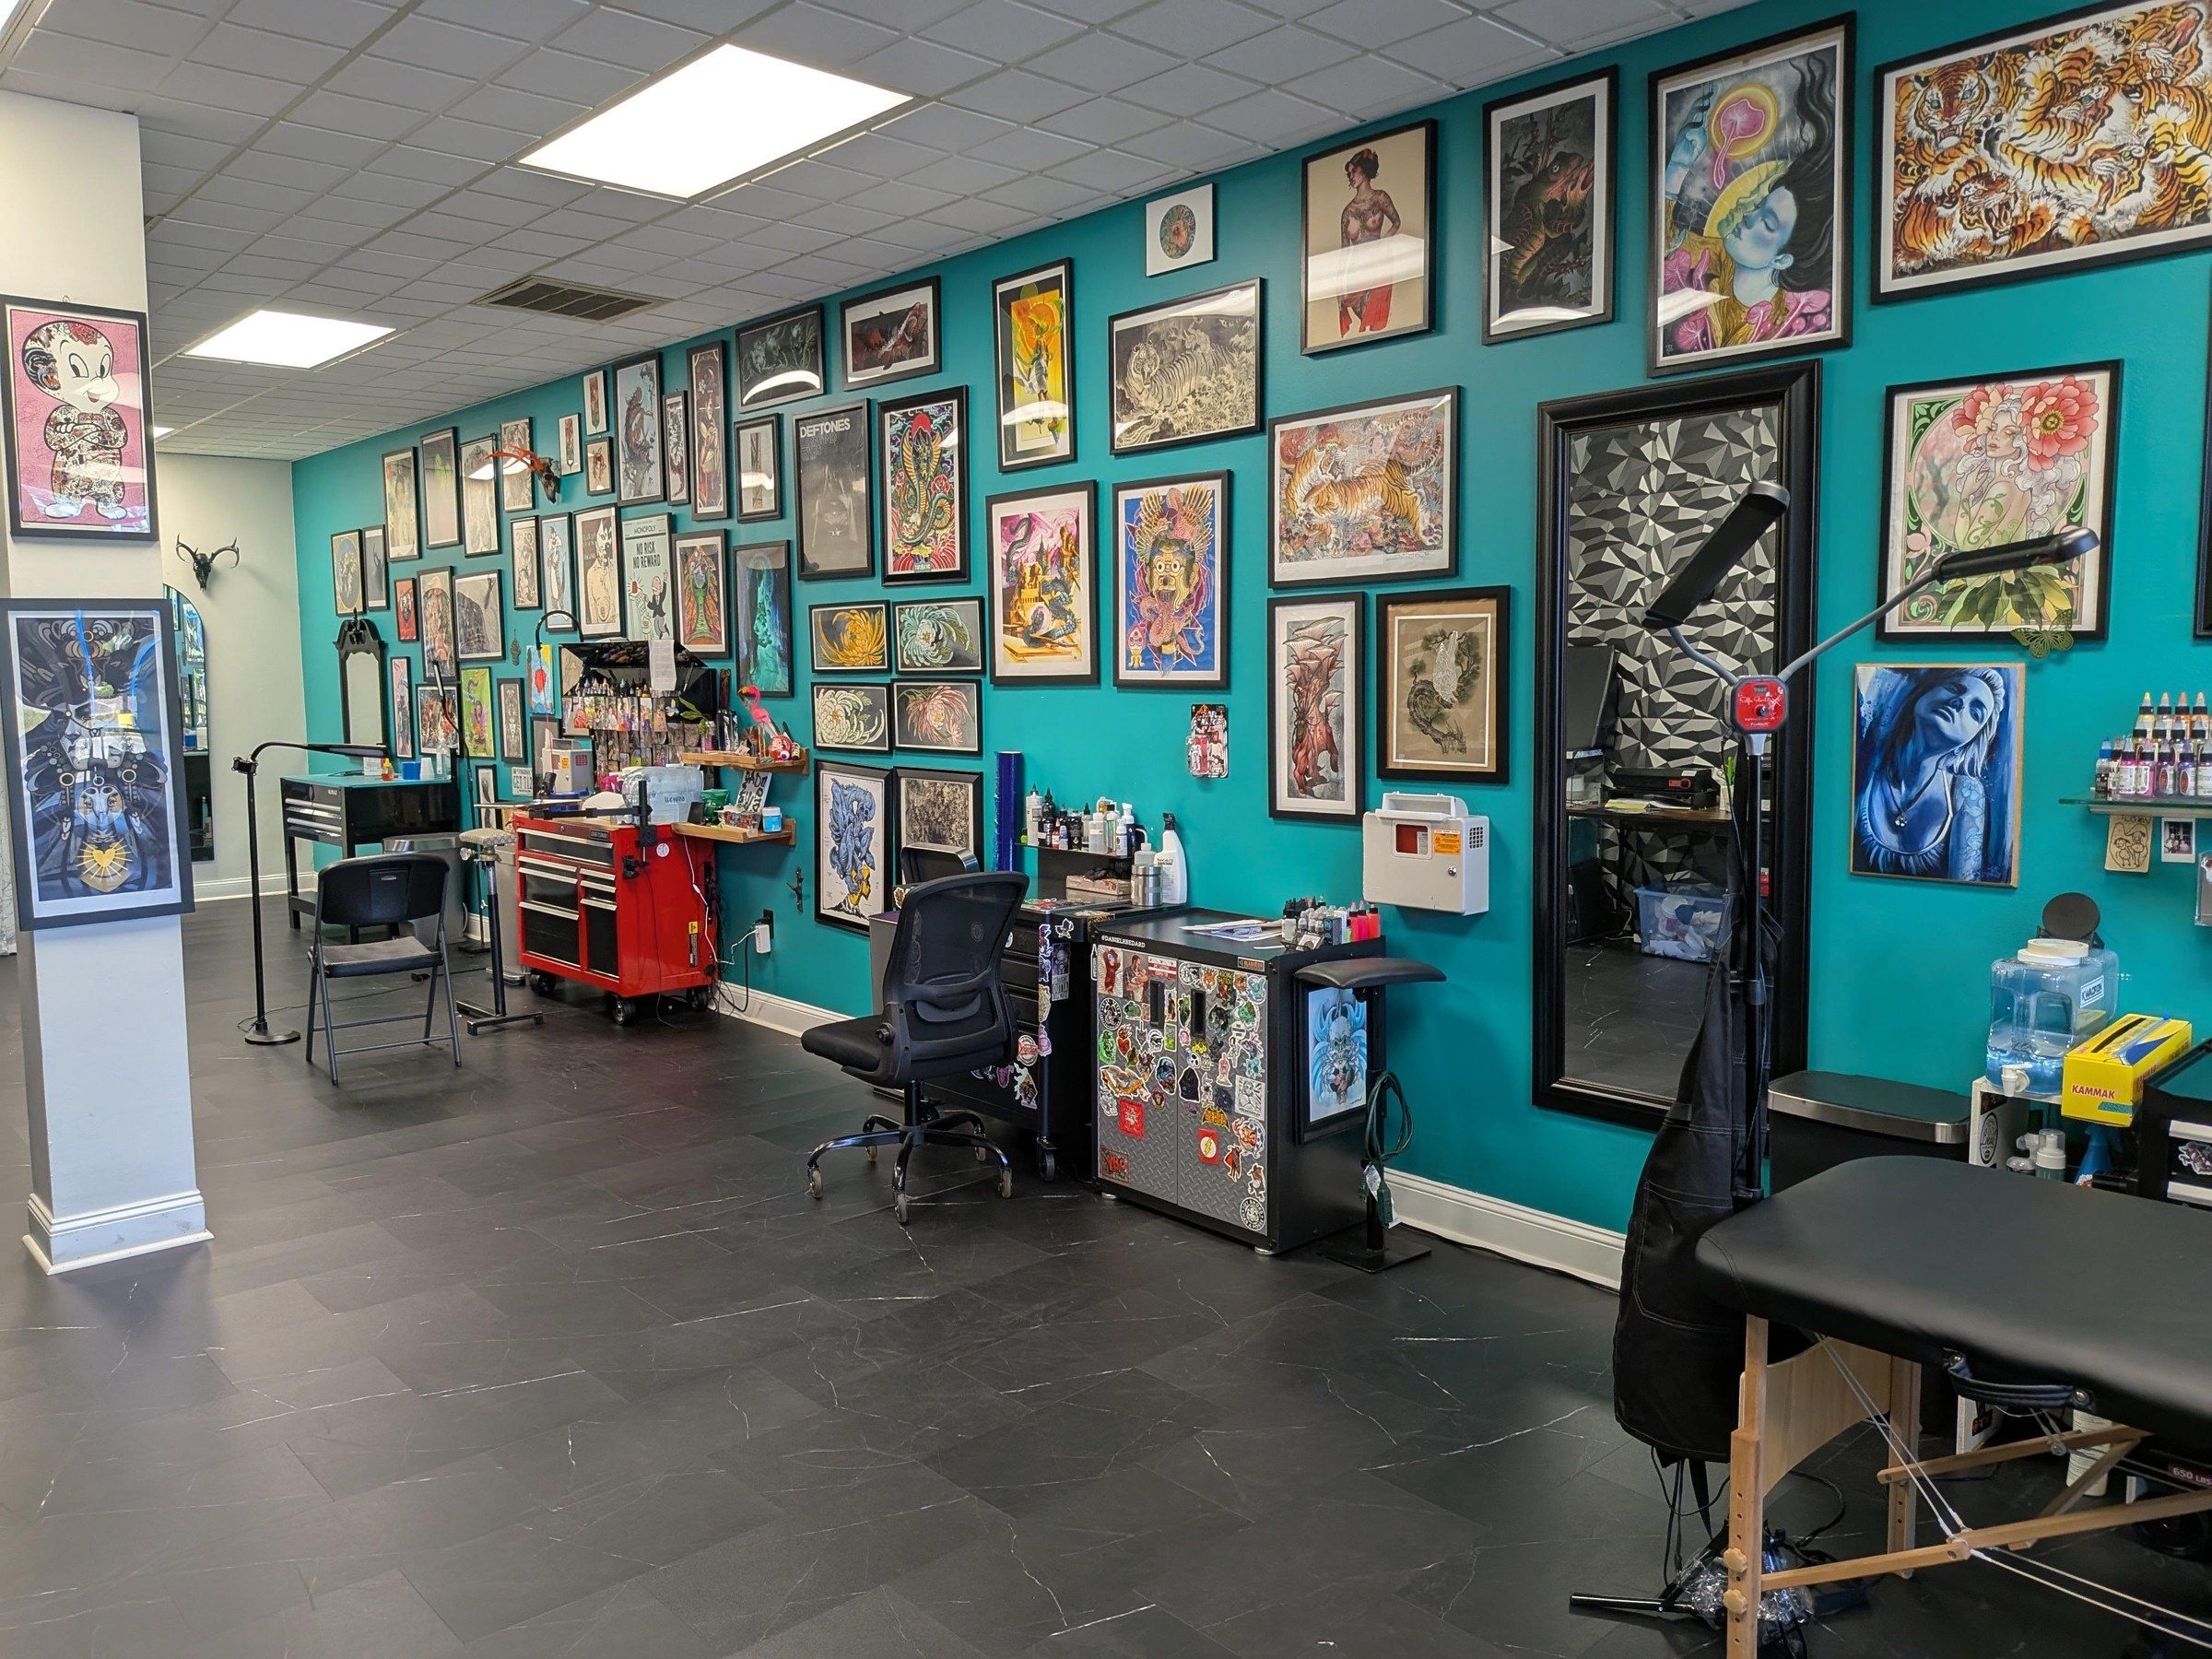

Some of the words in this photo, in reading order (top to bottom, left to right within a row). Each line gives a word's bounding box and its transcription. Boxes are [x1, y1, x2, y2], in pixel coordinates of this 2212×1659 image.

[800, 418, 851, 438] DEFTONES
[634, 524, 656, 534] MONOPOLY
[636, 542, 643, 555] NO
[643, 541, 656, 554] RISK
[632, 556, 640, 569] NO
[641, 554, 661, 568] REWARD
[2071, 1084, 2116, 1100] KAMMAK
[2172, 1466, 2194, 1480] 650
